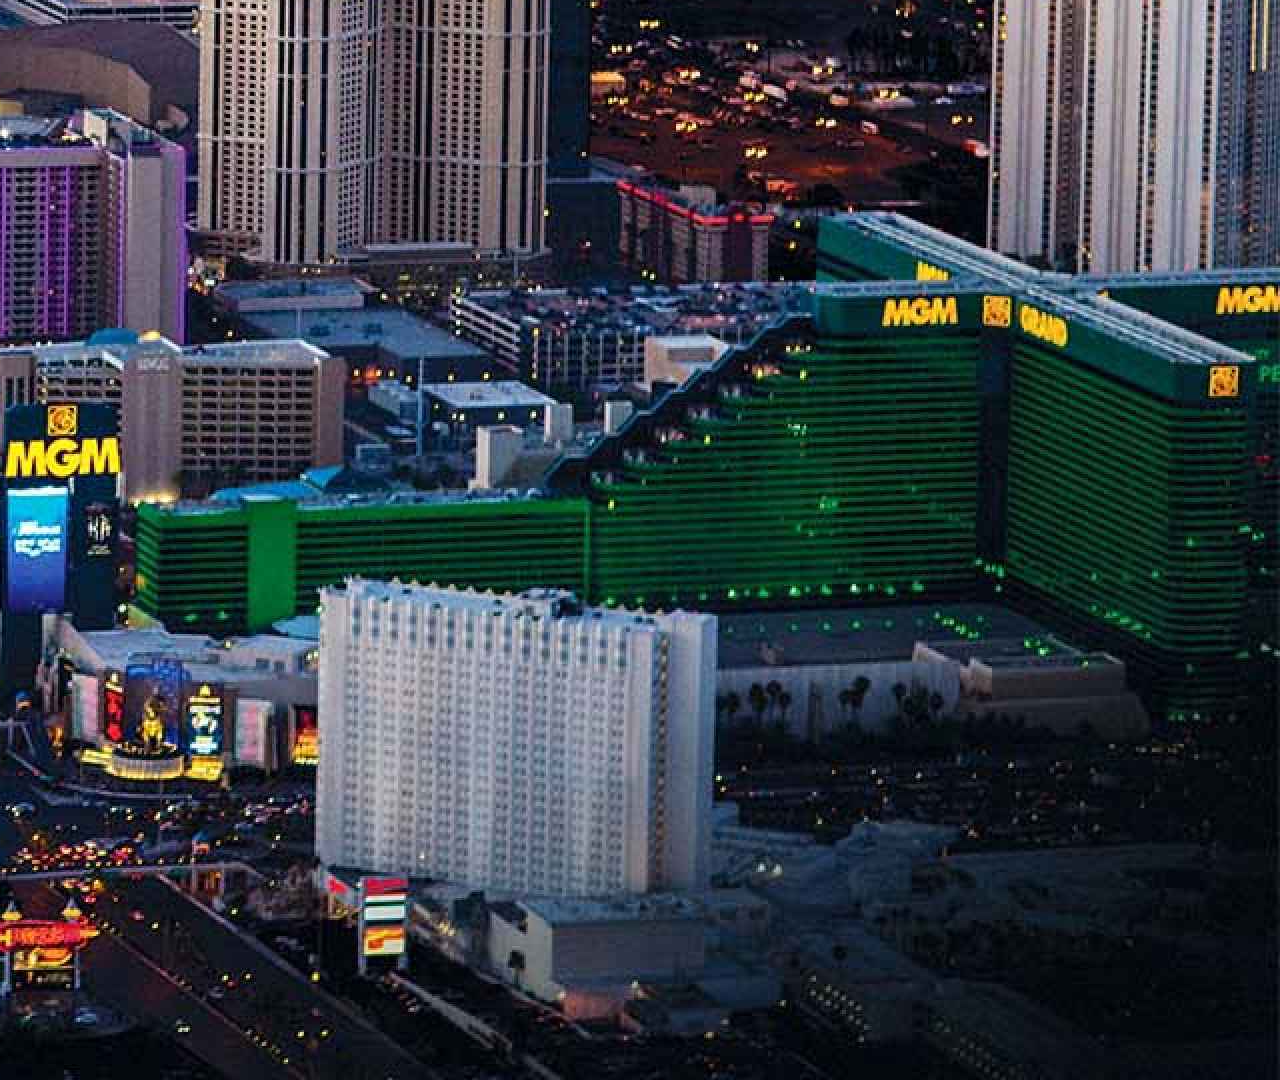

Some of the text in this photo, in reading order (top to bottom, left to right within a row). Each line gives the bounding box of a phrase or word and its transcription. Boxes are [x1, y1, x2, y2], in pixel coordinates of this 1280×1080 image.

[882, 297, 958, 327] MGM
[1021, 304, 1068, 347] GRAND
[5, 437, 121, 478] MGM
